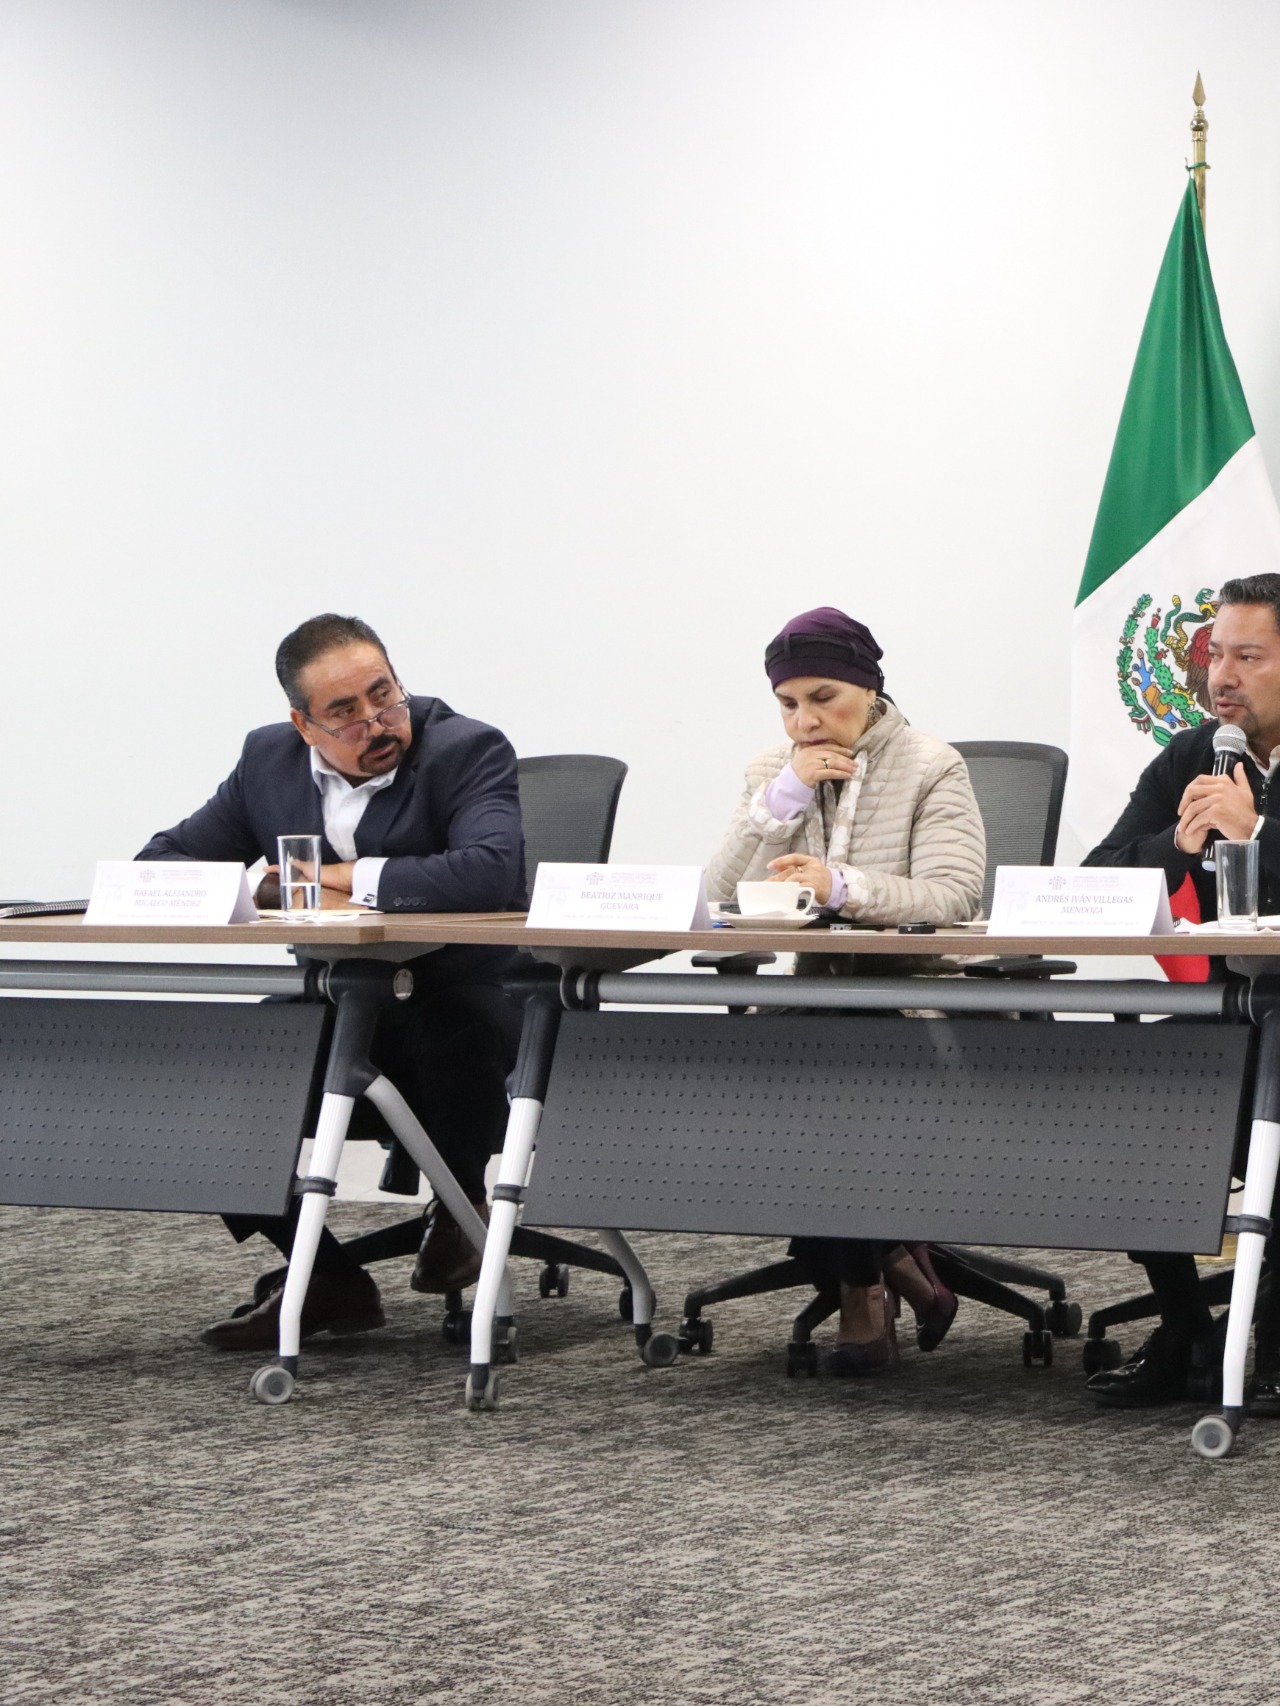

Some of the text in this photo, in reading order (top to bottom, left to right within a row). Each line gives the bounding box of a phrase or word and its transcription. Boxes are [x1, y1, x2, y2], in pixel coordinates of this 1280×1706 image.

[580, 891, 664, 902] BEATRIZ MANRIQUE
[1035, 893, 1134, 904] ANDRÉS IVÁN VILLEGAS
[600, 902, 639, 910] GUEVARA
[1061, 906, 1103, 914] MENDOZA
